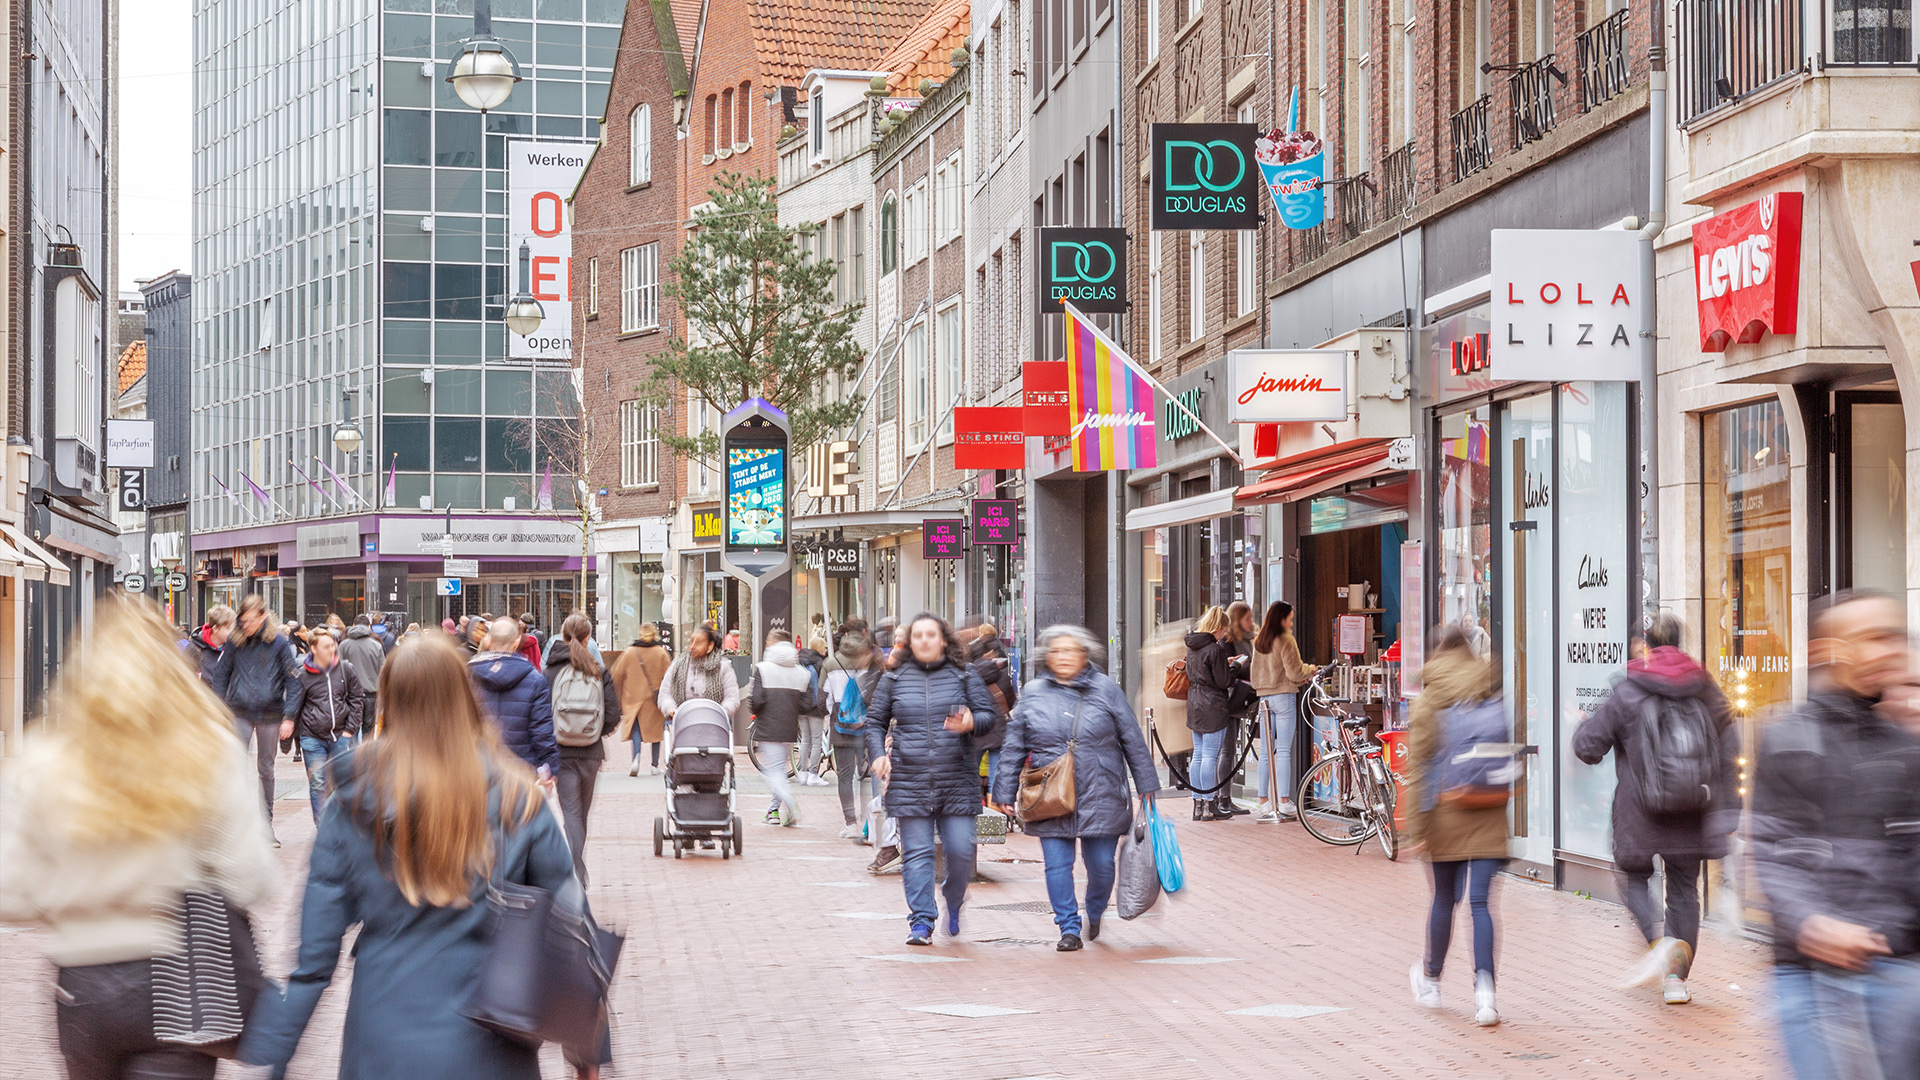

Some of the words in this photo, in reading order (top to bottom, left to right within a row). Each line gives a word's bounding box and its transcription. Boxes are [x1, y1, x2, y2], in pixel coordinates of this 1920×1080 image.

[527, 153, 584, 167] Werken
[1165, 196, 1246, 214] DOUGLAS
[531, 191, 563, 238] O
[532, 256, 560, 301] E
[1051, 286, 1116, 301] DOUGLAS
[1508, 282, 1630, 305] LOLA
[1508, 323, 1630, 346] LIZA
[528, 336, 571, 353] open
[1238, 371, 1341, 405] jamin
[1164, 385, 1201, 442] DOUGLAS
[1070, 408, 1155, 440] jamin
[984, 434, 1020, 442] STING
[732, 469, 748, 480] TENT
[750, 466, 758, 474] OP
[760, 462, 768, 471] DE
[735, 475, 757, 488] STADSE
[759, 469, 776, 481] MERT
[1525, 470, 1549, 509] larks
[763, 494, 781, 505] 2020
[988, 506, 1002, 516] ICI
[936, 526, 950, 534] ICI
[980, 518, 1010, 527] PARIS
[421, 533, 489, 542] WARHOUSE
[492, 534, 508, 542] OF
[511, 534, 576, 543] INNOVATION
[930, 535, 956, 544] PARIS
[988, 528, 1002, 538] XL
[827, 548, 857, 563] P&B
[938, 544, 949, 552] XL
[1578, 553, 1608, 590] Clarks
[1582, 608, 1607, 629] WE'RE
[1567, 642, 1595, 664] NEARLY
[1597, 642, 1624, 664] READY
[1720, 656, 1757, 672] BALLOON
[1762, 656, 1789, 672] JEANS
